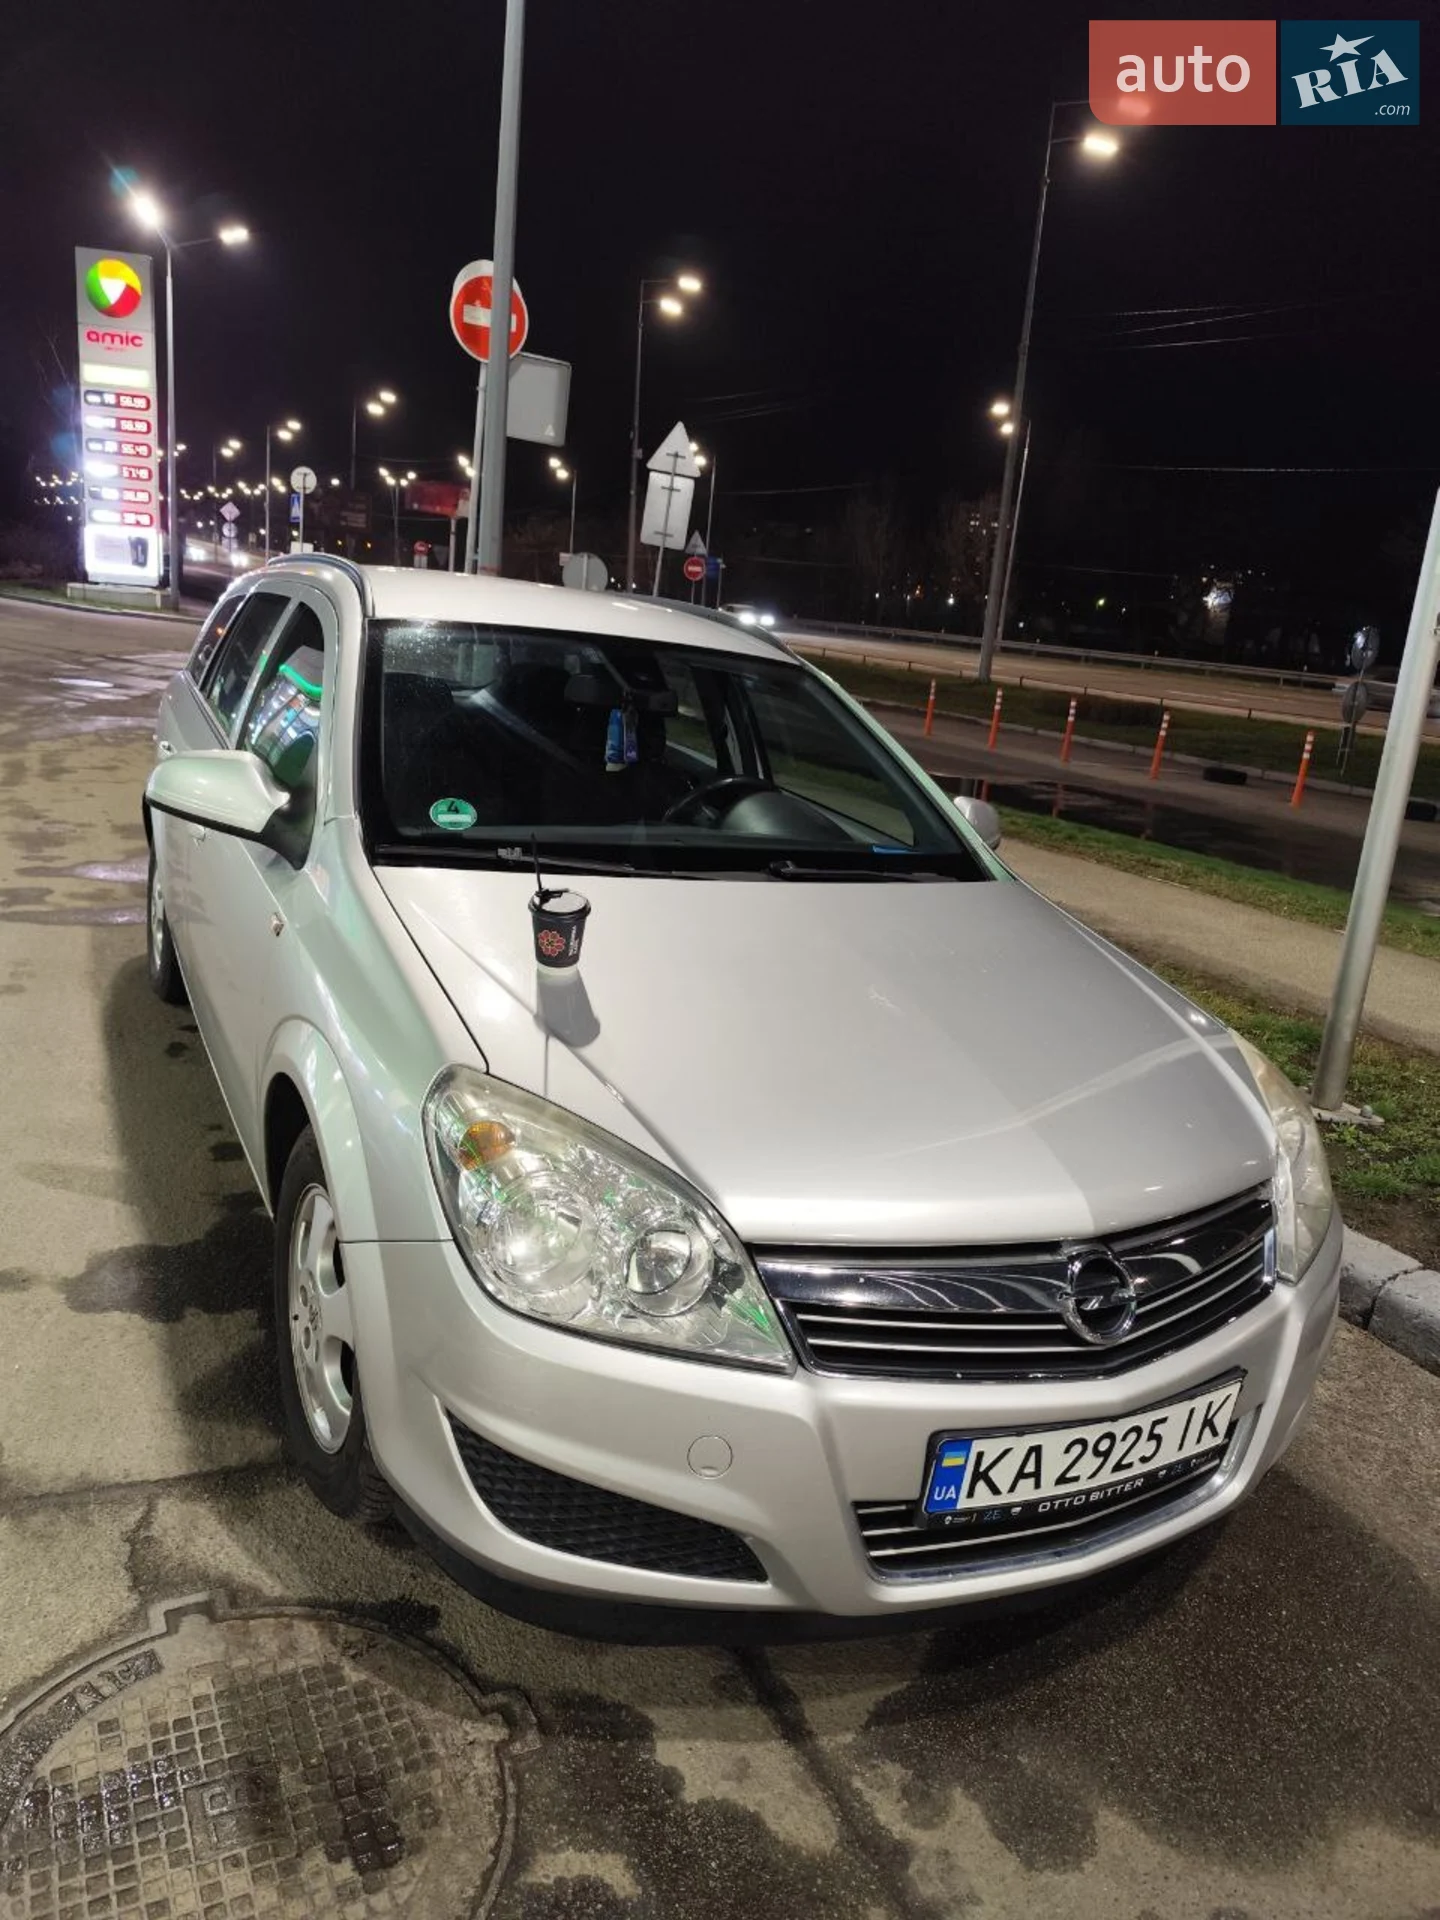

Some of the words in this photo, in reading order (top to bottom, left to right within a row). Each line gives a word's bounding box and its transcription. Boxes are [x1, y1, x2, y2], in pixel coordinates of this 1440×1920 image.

[86, 330, 143, 347] amic
[966, 1444, 1043, 1499] KA
[1054, 1416, 1169, 1487] 2925
[1177, 1393, 1232, 1452] IK
[934, 1485, 957, 1501] UA
[1038, 1494, 1086, 1513] OTTO
[1089, 1477, 1144, 1502] BITTER
